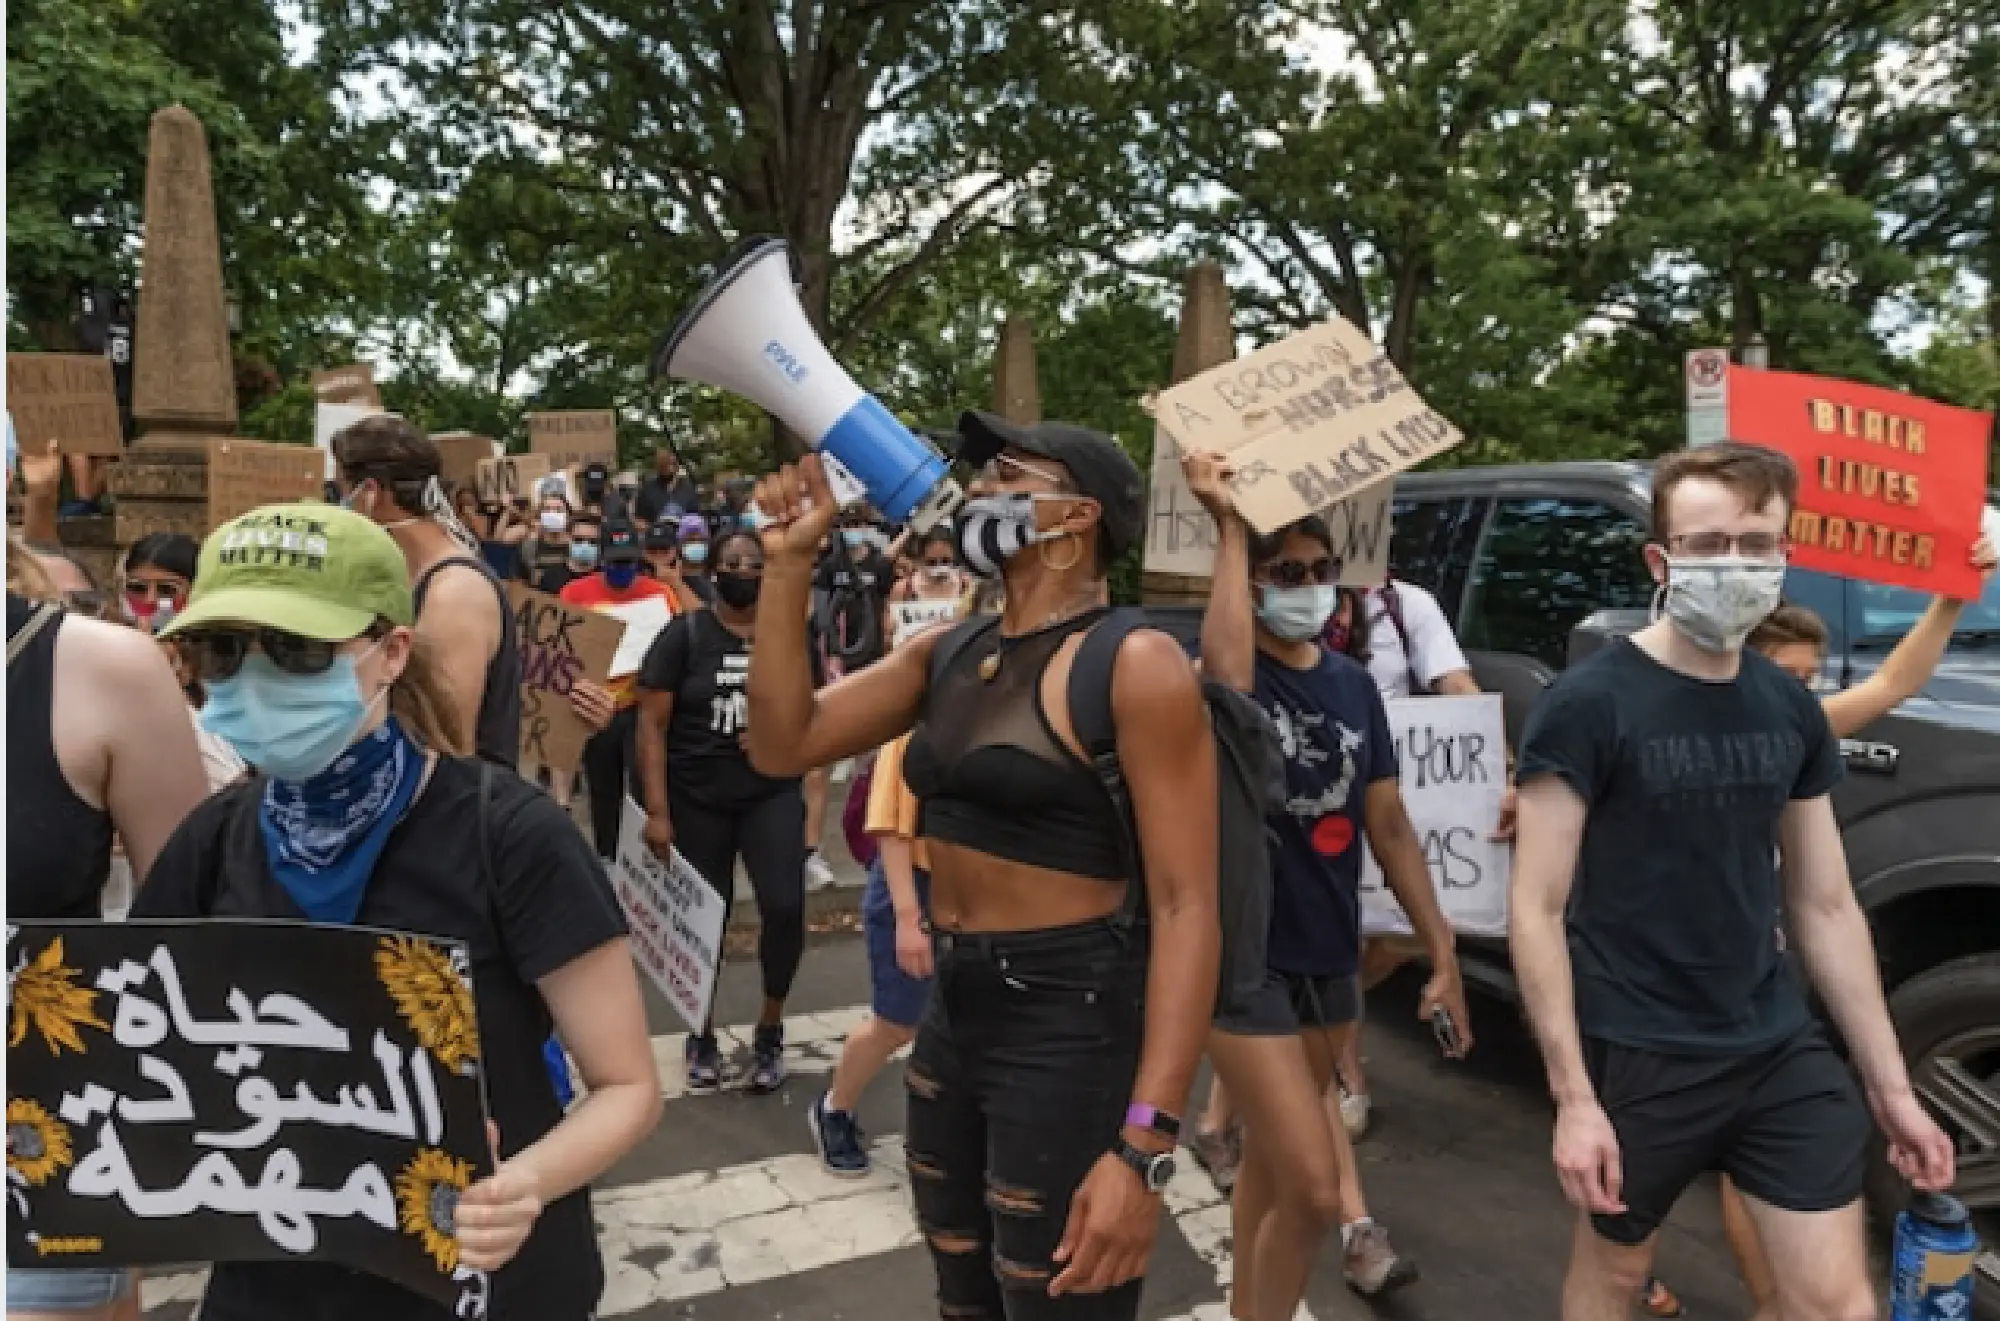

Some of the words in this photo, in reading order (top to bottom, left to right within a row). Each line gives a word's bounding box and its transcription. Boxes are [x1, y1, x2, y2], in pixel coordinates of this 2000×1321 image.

[1173, 400, 1212, 431] A
[1213, 337, 1351, 411] BROWN
[1287, 436, 1391, 506] BLACK
[1790, 509, 1935, 568] MATTER
[517, 598, 586, 654] ACK
[1407, 724, 1489, 790] YOUR
[95, 943, 350, 1076] حياة
